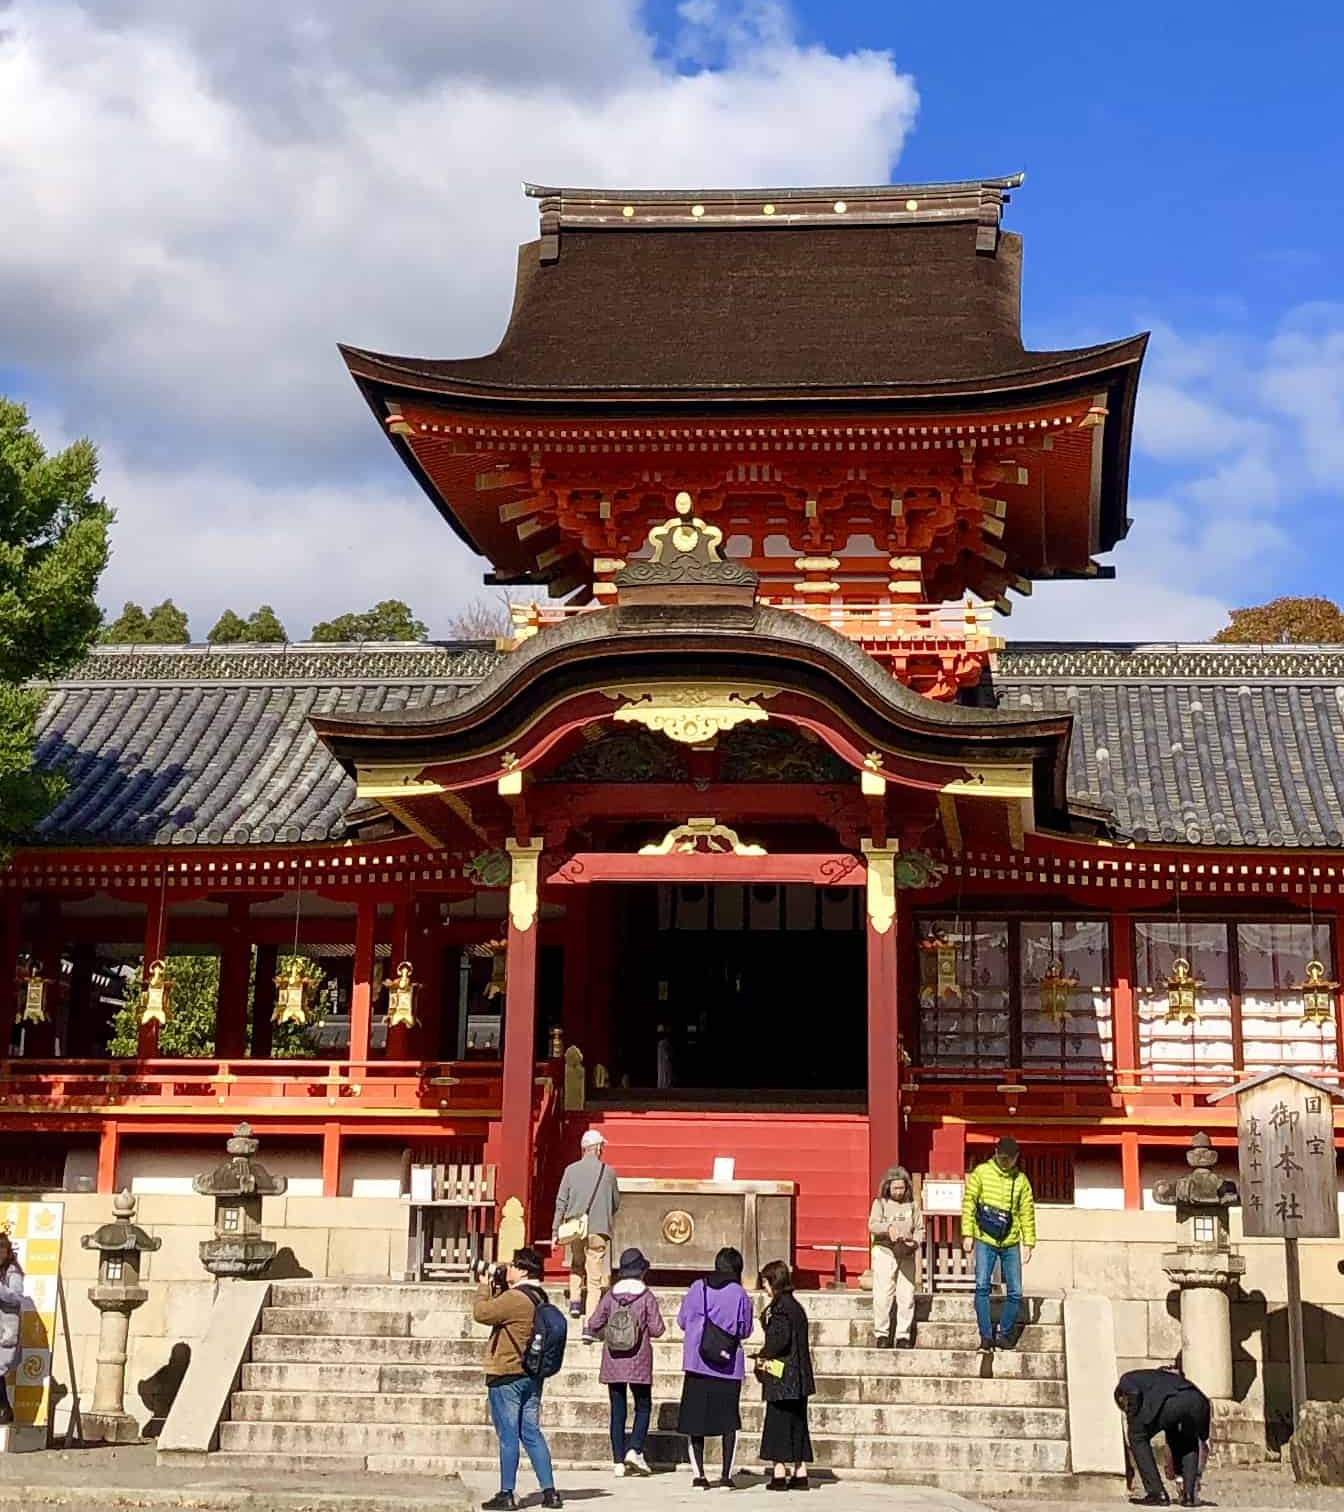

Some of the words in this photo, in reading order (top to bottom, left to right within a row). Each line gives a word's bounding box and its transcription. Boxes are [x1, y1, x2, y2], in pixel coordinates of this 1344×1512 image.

[1268, 1099, 1304, 1223] 御本社
[1304, 1095, 1326, 1156] 国宝
